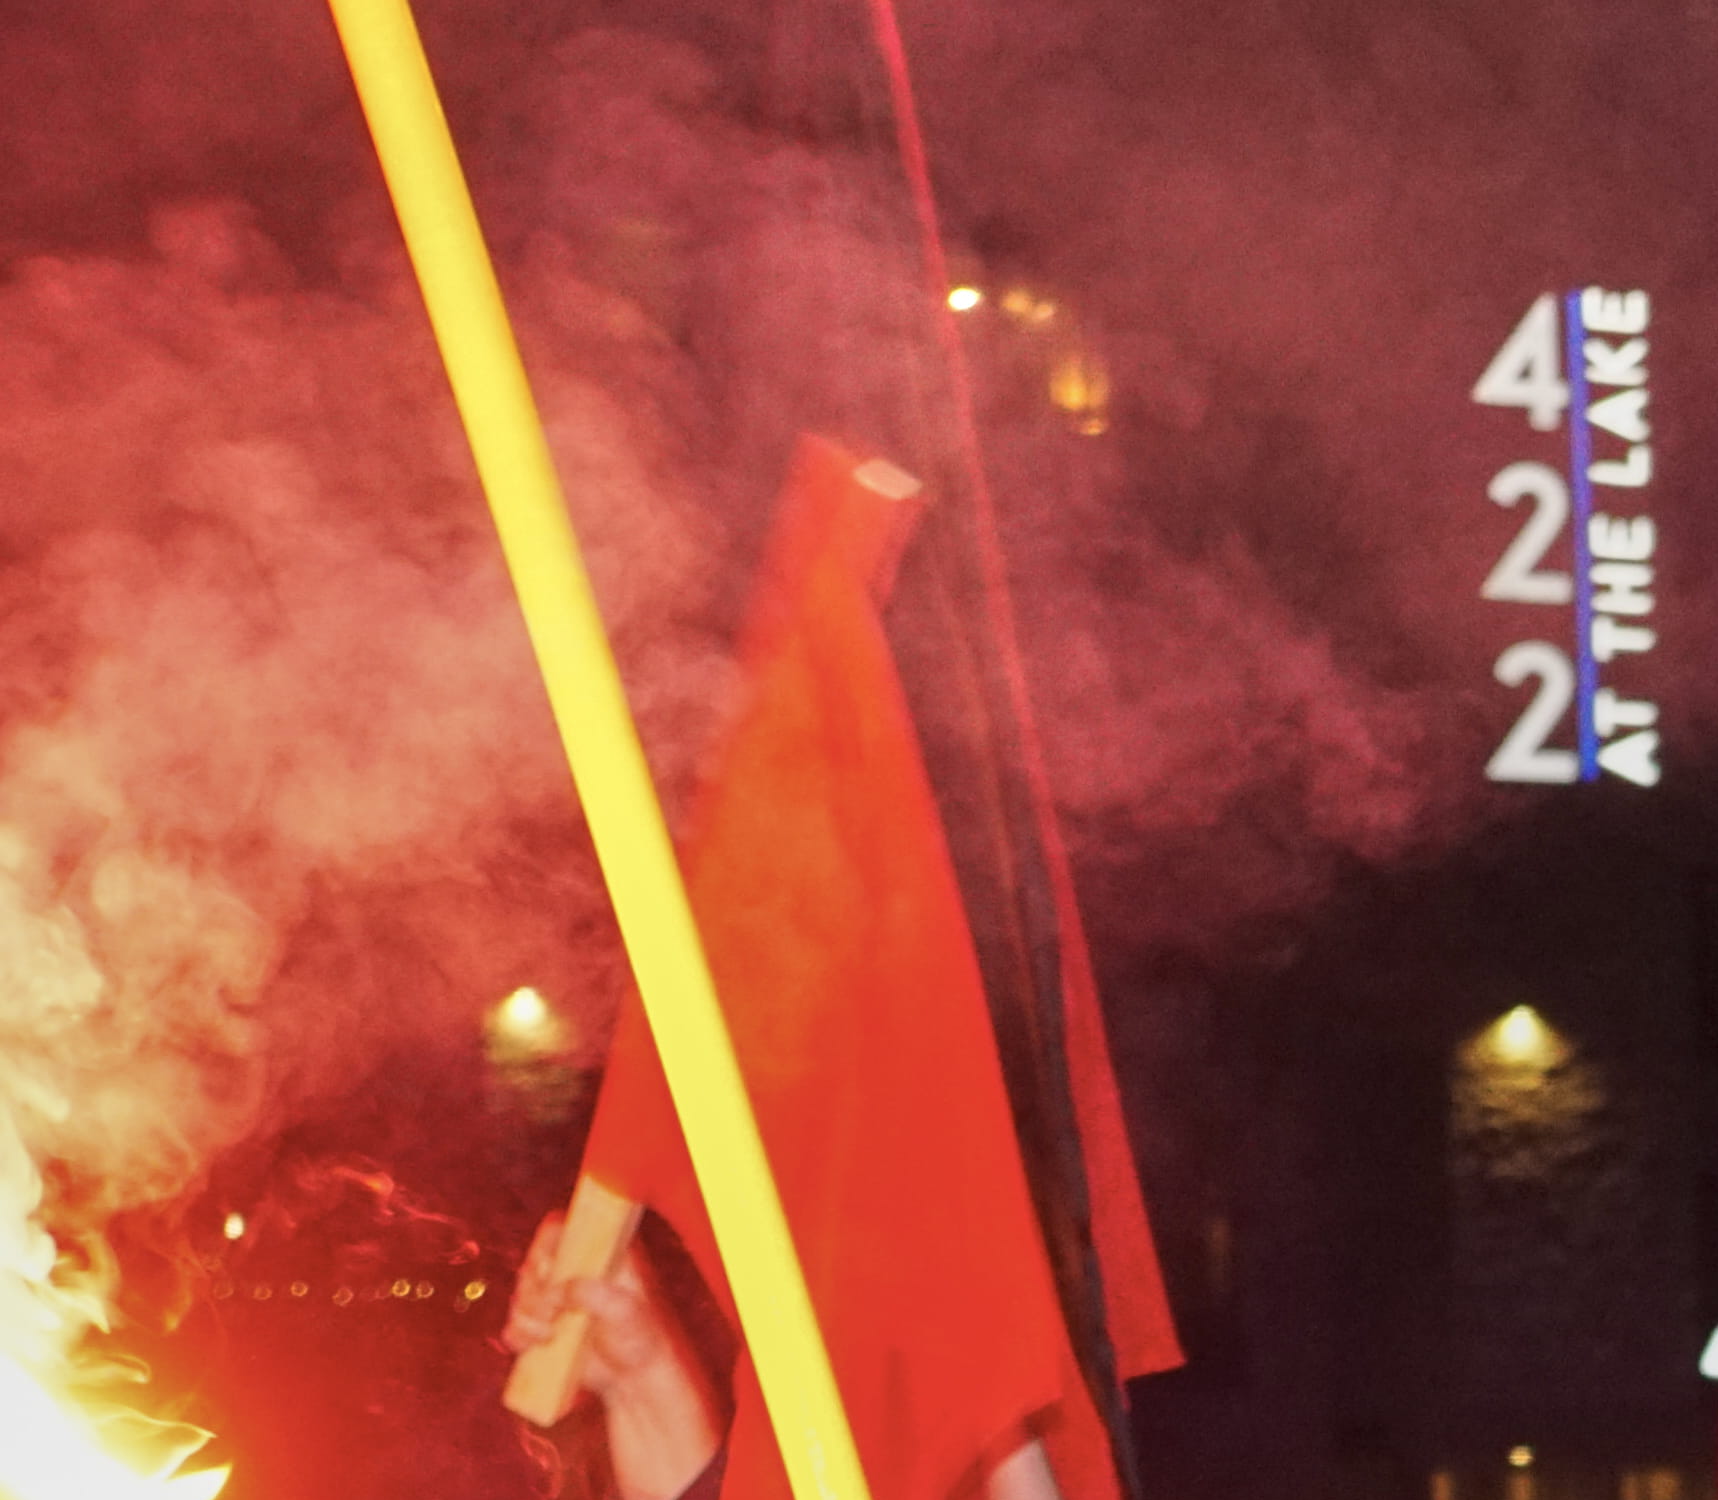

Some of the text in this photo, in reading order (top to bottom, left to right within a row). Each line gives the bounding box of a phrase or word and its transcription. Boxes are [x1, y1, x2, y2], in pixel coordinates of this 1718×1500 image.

[1581, 286, 1660, 787] AT THE LAKE
